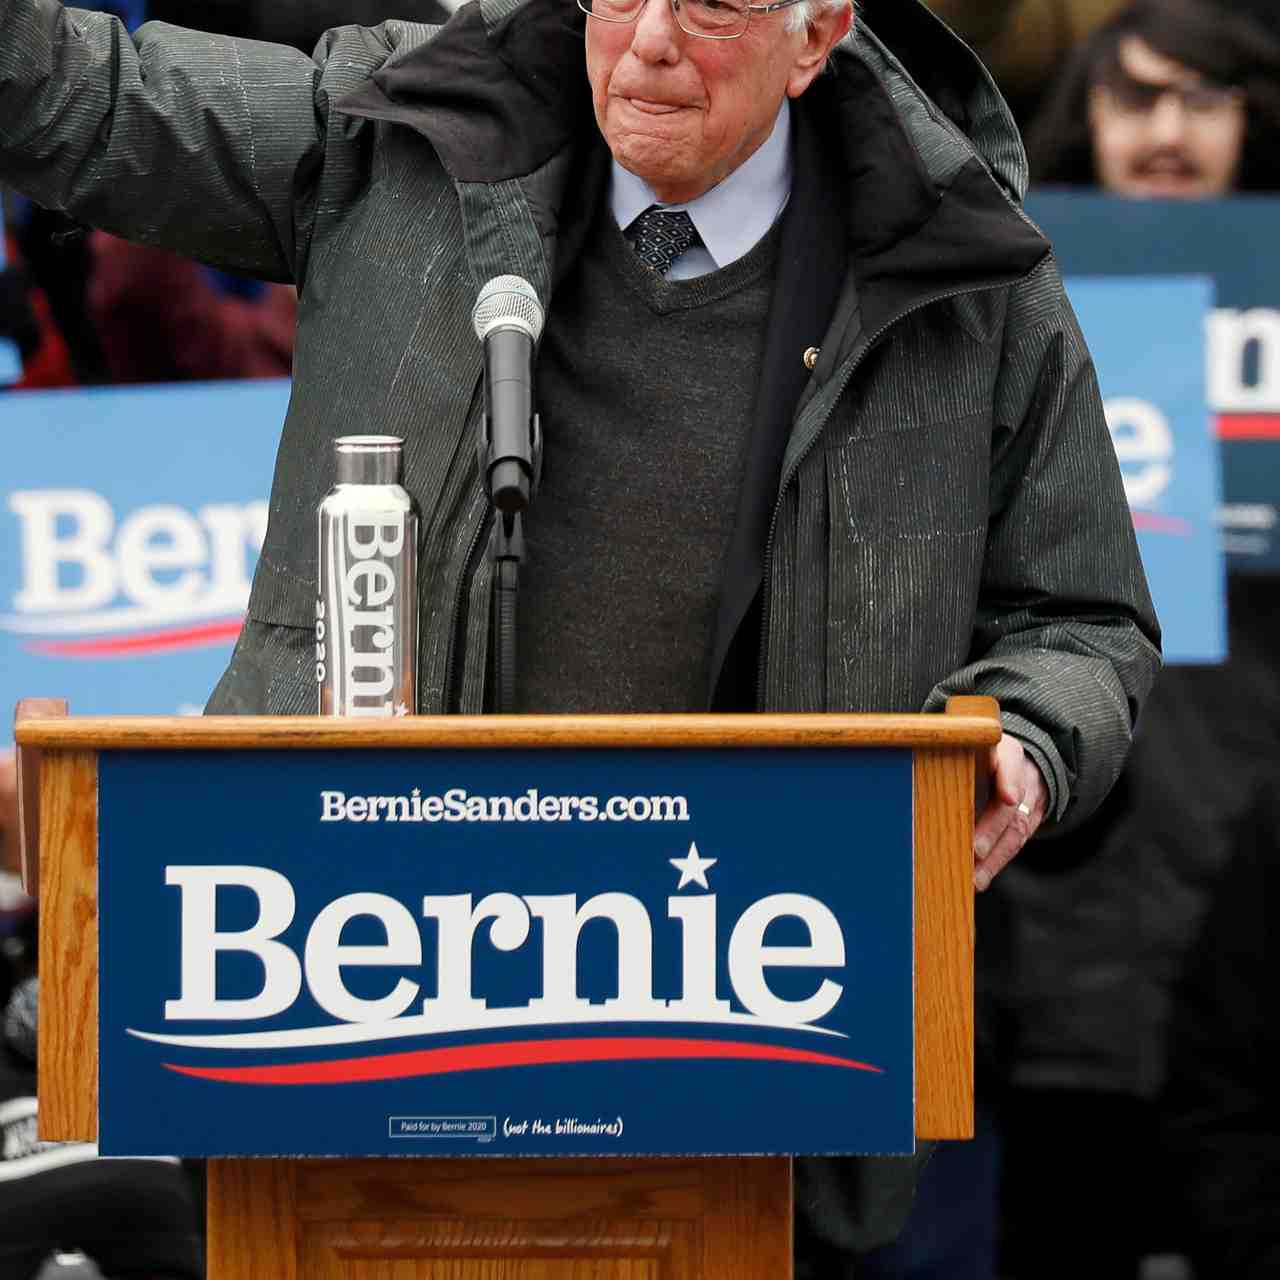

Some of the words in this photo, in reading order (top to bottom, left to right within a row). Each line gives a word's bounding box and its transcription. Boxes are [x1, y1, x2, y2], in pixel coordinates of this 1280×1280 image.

[7, 486, 265, 620] Ber
[346, 511, 409, 717] Berni
[321, 786, 689, 822] BernieSanders.com
[164, 841, 847, 1024] Bernie
[401, 1120, 417, 1131] Paid
[442, 1120, 466, 1131] Bernie
[468, 1121, 487, 1131] 2020
[531, 1119, 552, 1134] the
[555, 1116, 624, 1138] billionaires)
